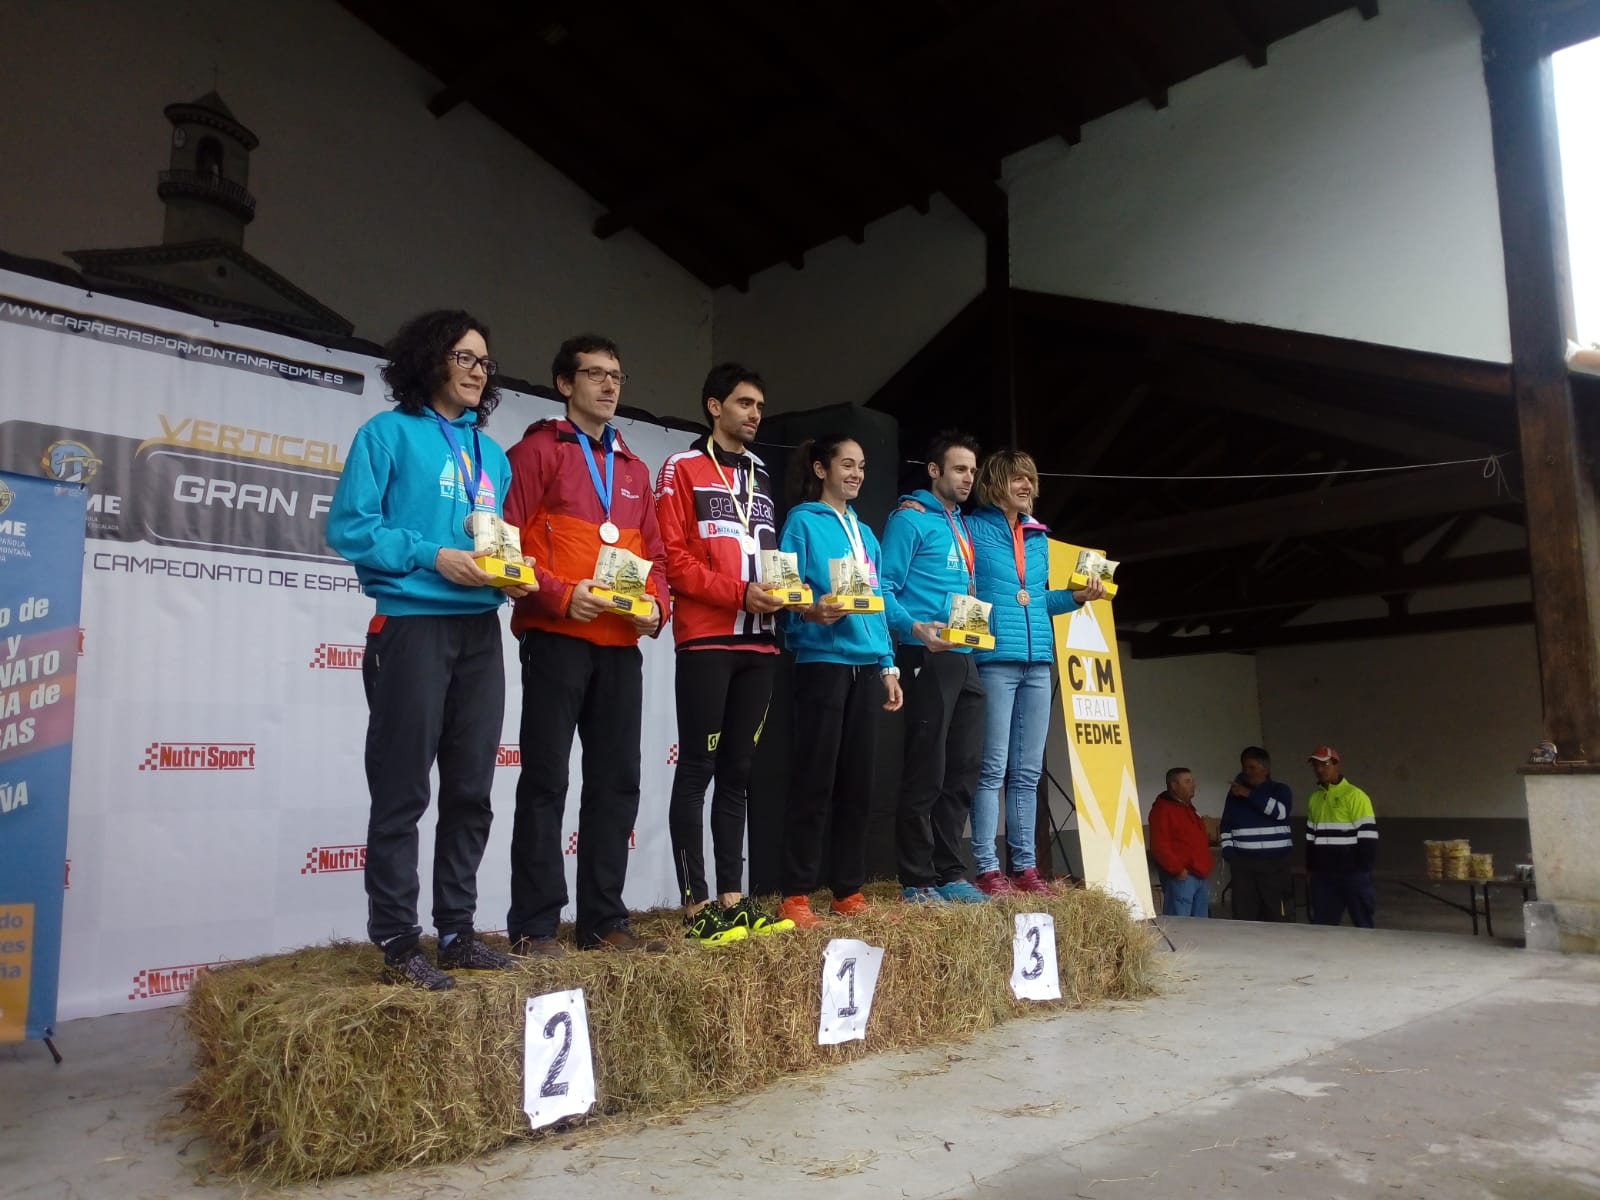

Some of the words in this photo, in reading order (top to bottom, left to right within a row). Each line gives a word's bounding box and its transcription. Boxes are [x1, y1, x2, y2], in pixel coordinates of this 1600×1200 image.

[158, 414, 345, 472] VERTICAL
[173, 474, 299, 517] GRAN
[93, 552, 263, 585] CAMPEONATO
[268, 571, 299, 589] DE
[18, 596, 50, 623] de
[6, 633, 23, 660] y
[0, 649, 60, 689] NATO
[1067, 654, 1116, 693] CXM
[29, 683, 61, 710] de
[1076, 697, 1116, 719] TRAIL
[0, 717, 36, 750] AS
[1075, 722, 1123, 745] FEDME
[159, 745, 256, 768] NutriSport
[1021, 926, 1045, 981] 3
[836, 956, 860, 1018] 1
[540, 1010, 573, 1098] 2
